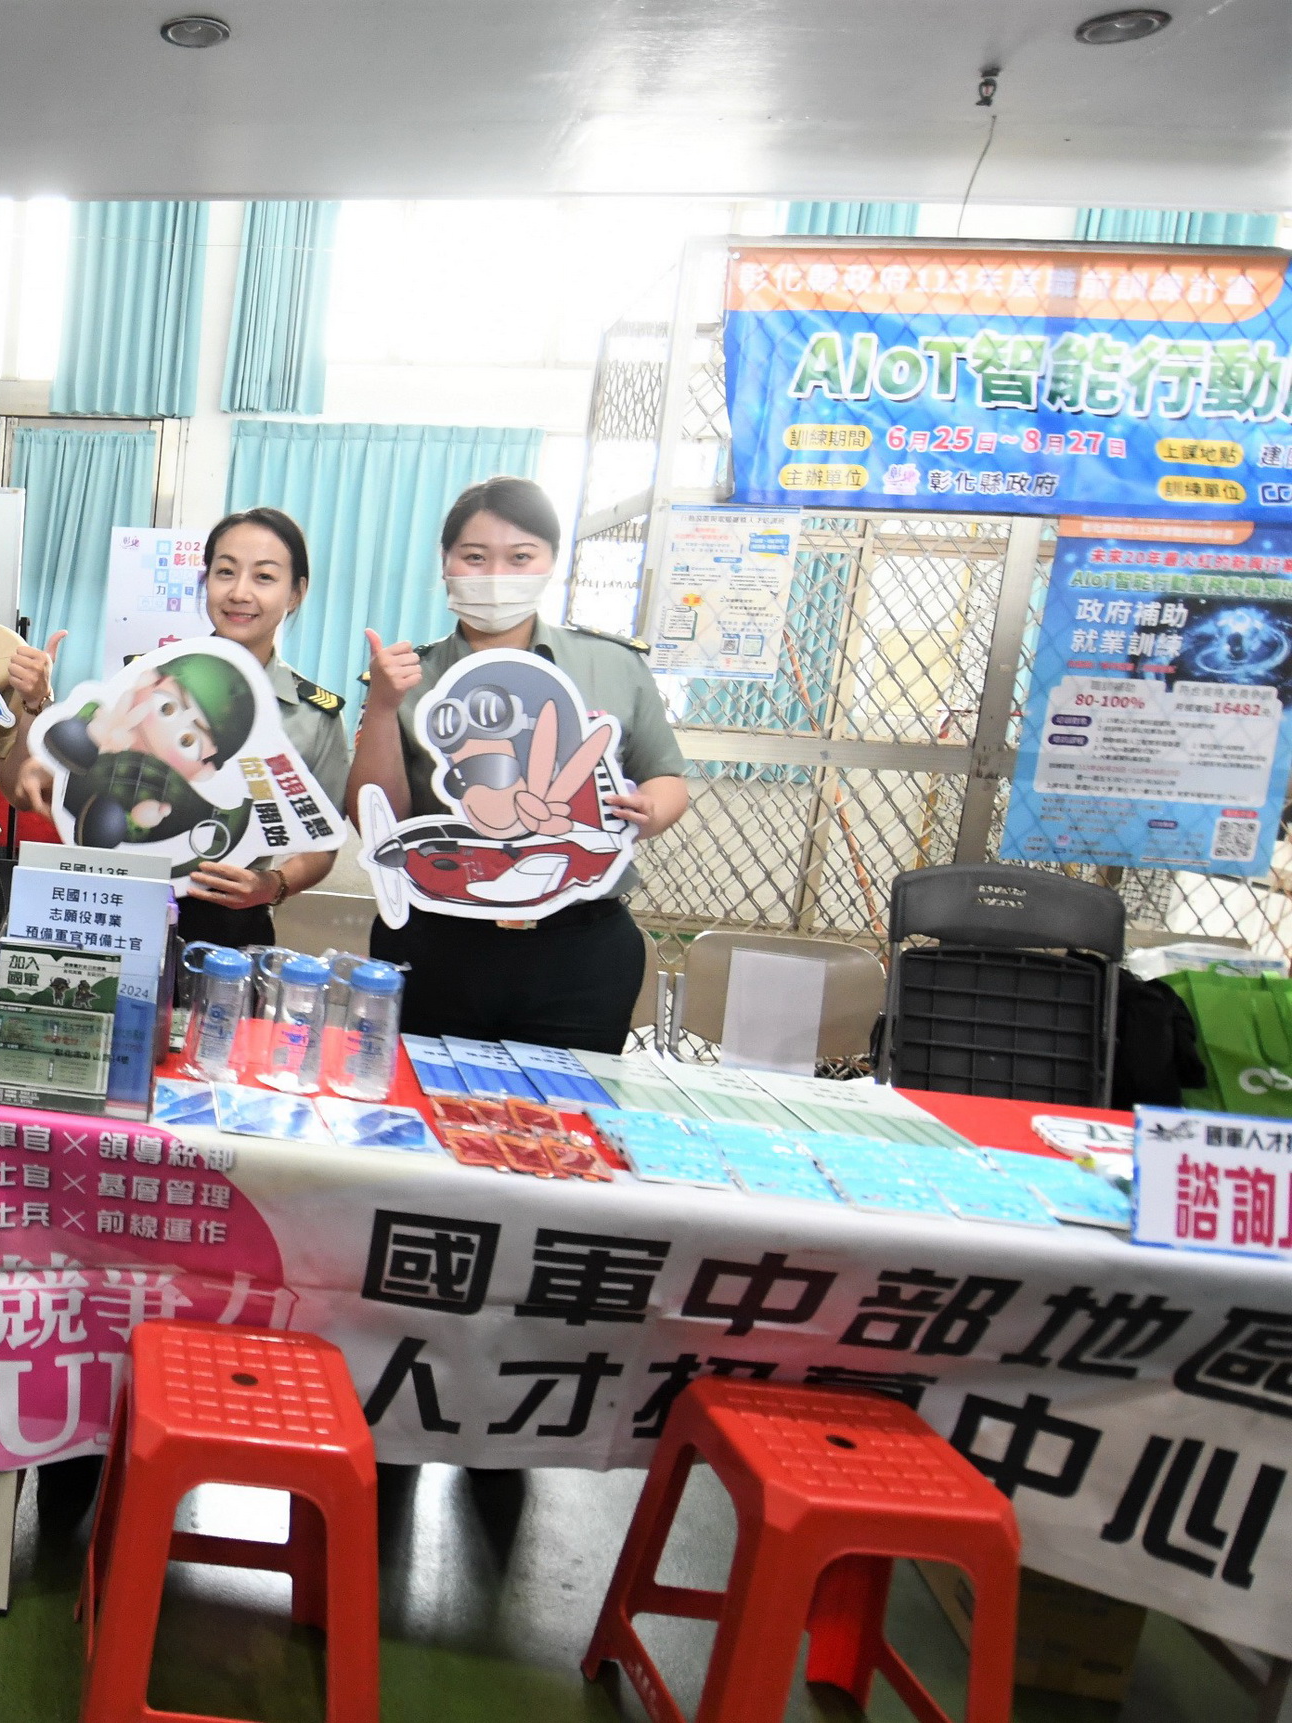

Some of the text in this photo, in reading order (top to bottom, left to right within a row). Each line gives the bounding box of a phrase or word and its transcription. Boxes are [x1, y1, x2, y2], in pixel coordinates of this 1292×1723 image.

[791, 329, 1292, 424] AIoT智能行動
[790, 428, 866, 448] 訓練期間
[784, 469, 862, 487] 主辦單位
[929, 471, 1059, 496] 彰化縣政府
[175, 541, 206, 552] 202
[173, 553, 206, 567] 彰化
[1075, 598, 1189, 629] 政府補助
[1071, 628, 1184, 658] 就業訓練
[1074, 692, 1146, 710] 80-100%
[51, 886, 124, 907] 民國113年
[48, 907, 123, 928] 志願役專業
[25, 925, 143, 951] 預備軍官預備士官
[8, 954, 41, 972] 加入
[7, 971, 40, 988] 國軍
[119, 983, 149, 999] 2024
[1175, 1153, 1292, 1249] 諮詢
[362, 1208, 1292, 1416] 國軍中部地區
